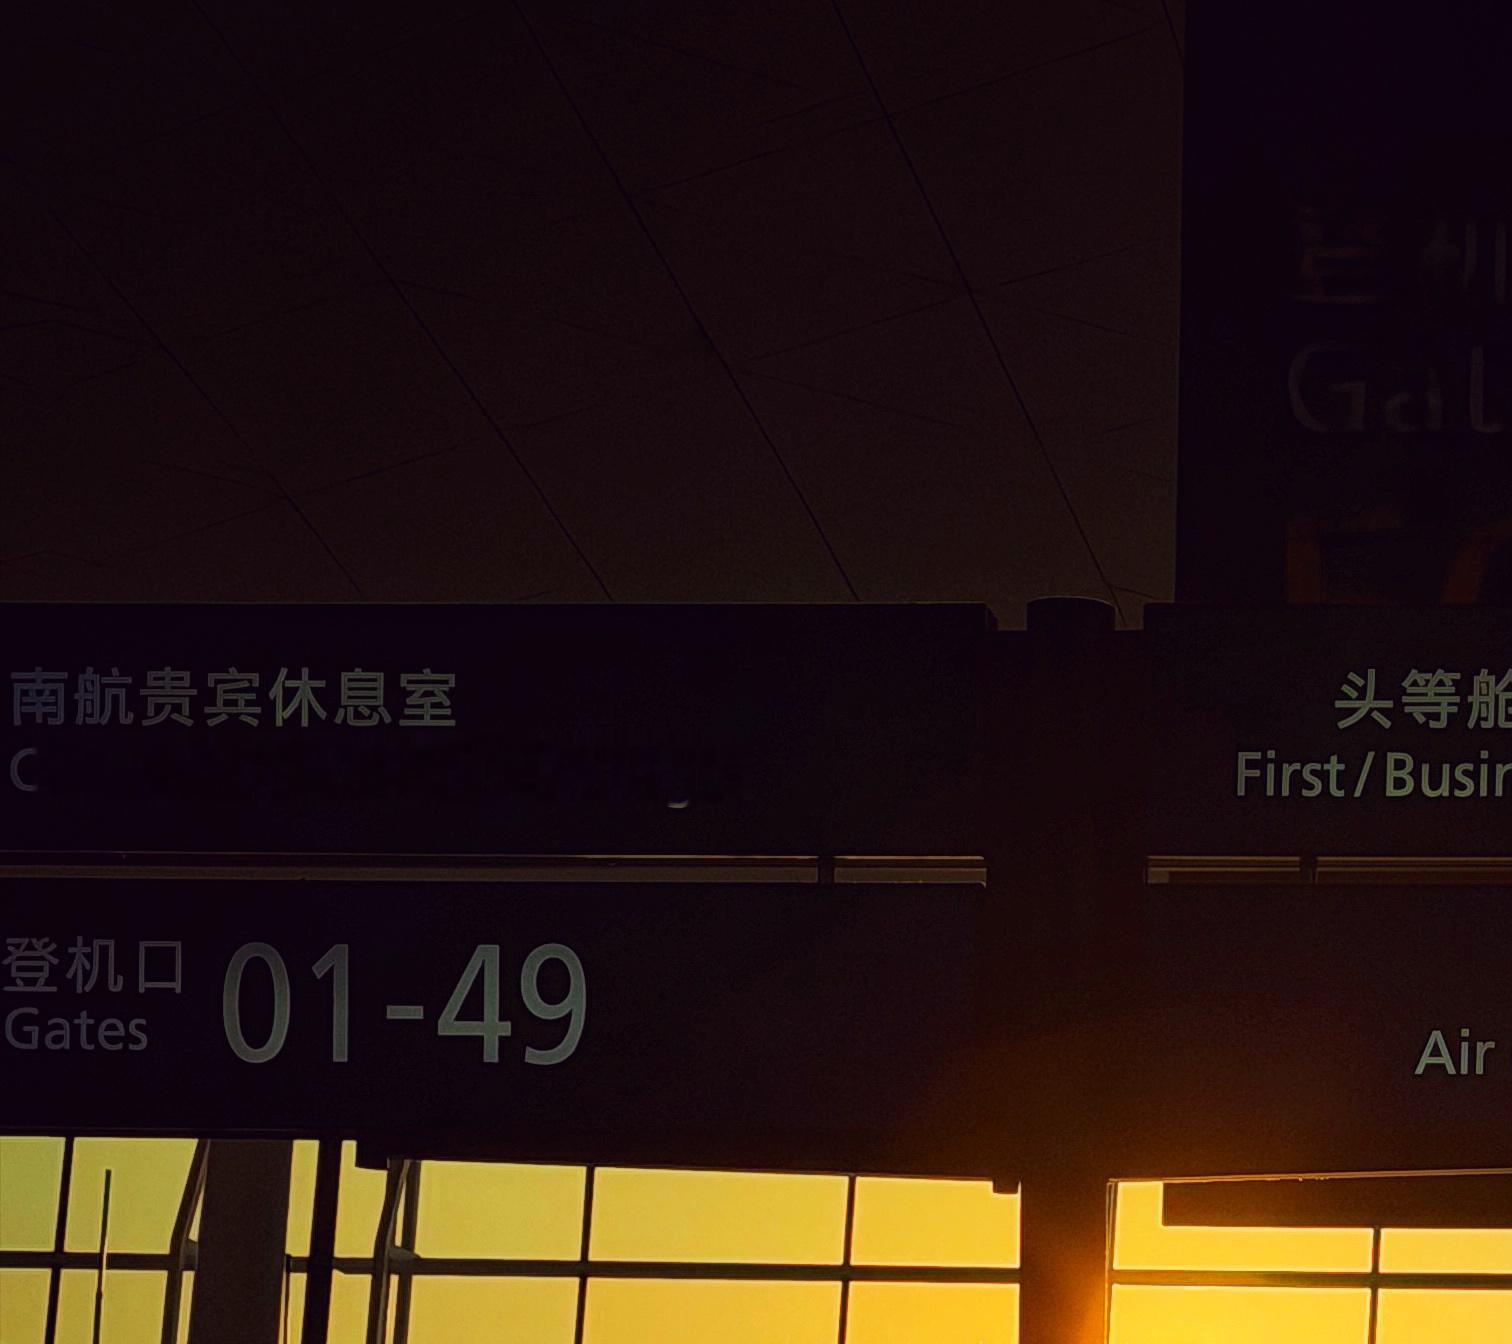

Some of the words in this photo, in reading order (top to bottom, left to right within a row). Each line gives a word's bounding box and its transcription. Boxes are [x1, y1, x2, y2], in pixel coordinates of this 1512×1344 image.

[9, 666, 457, 728] 南航贵宾休息室
[1, 935, 184, 995] 登机口
[4, 1006, 149, 1052] Gates
[222, 942, 588, 1066] 01-49
[1414, 1028, 1496, 1076] Air
